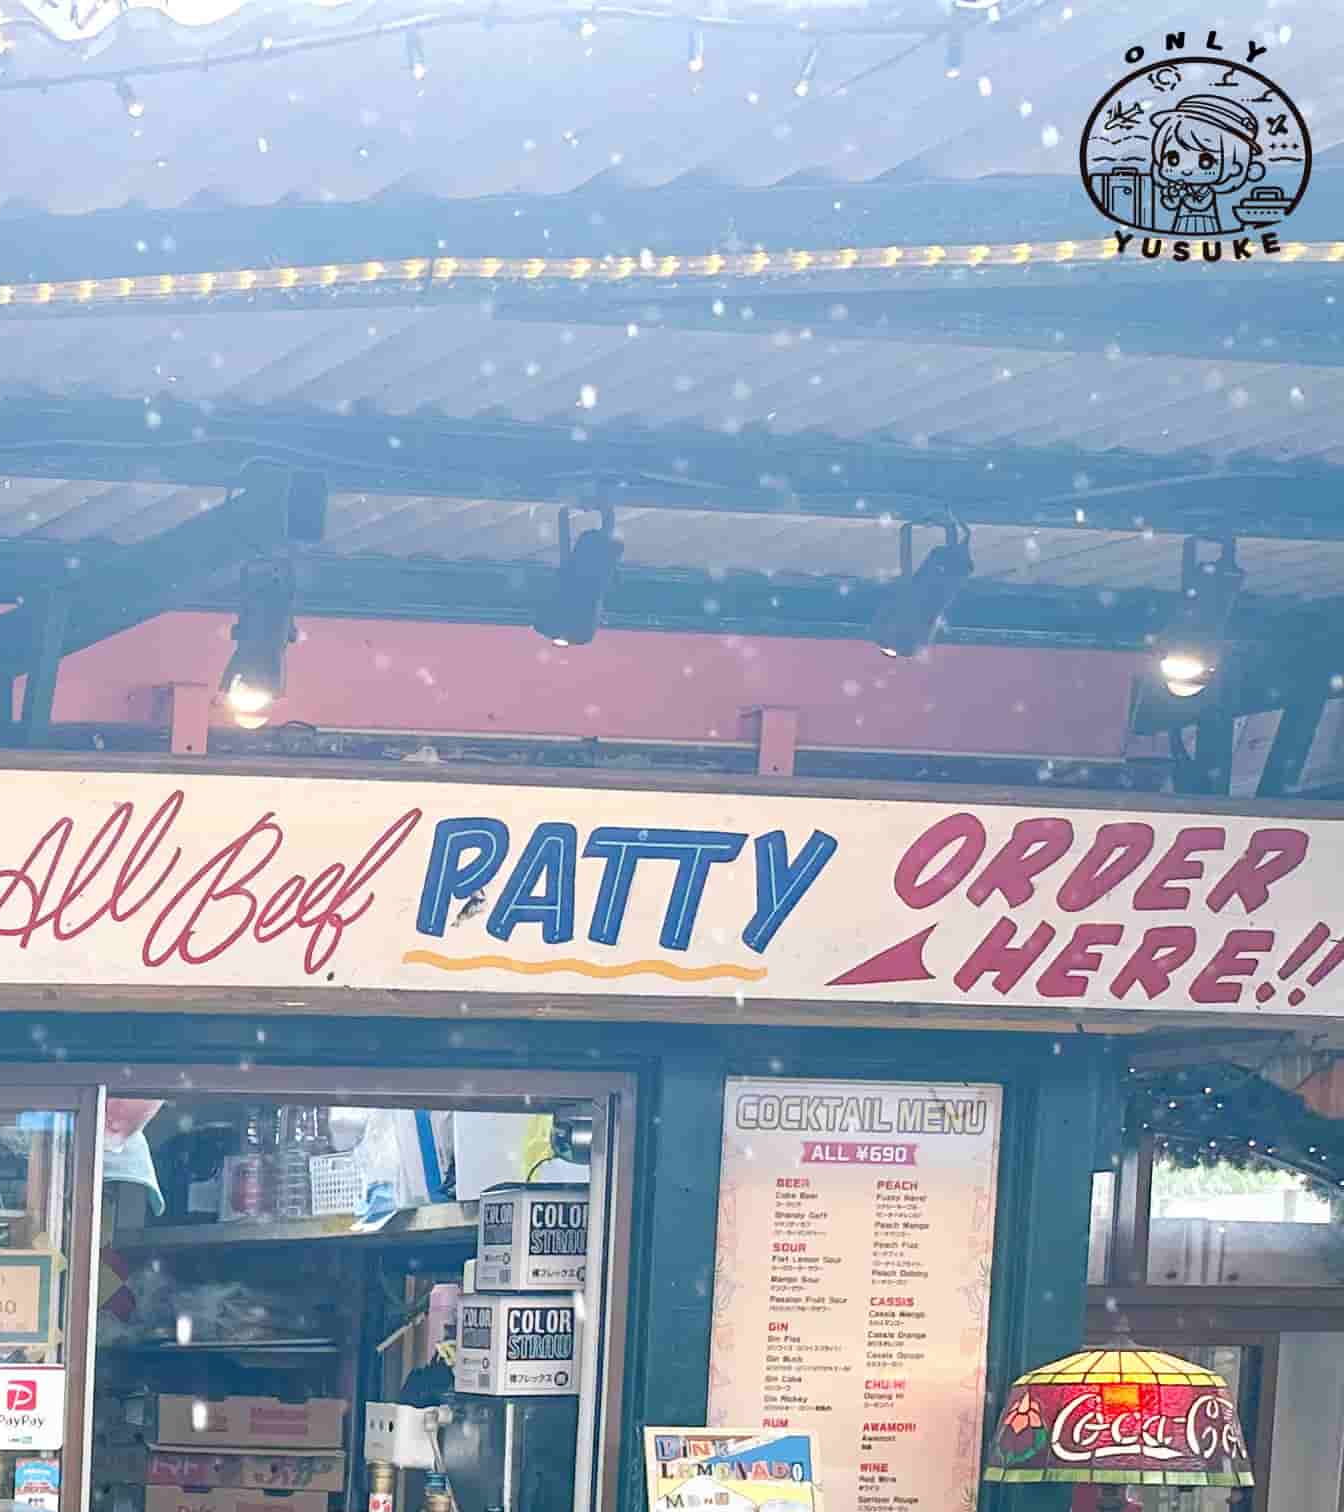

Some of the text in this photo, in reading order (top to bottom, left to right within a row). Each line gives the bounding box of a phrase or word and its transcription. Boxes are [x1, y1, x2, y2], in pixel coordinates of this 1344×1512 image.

[893, 812, 1310, 915] ORDER
[143, 807, 424, 975] Beef
[414, 815, 840, 955] PATTY
[953, 915, 1344, 1007] HERE!!
[735, 1093, 987, 1136] COCKTAIL MENU
[810, 1144, 908, 1163] ALL ¥690
[775, 1177, 919, 1191] BEER PEACH
[531, 1203, 588, 1229] COLO
[772, 1242, 807, 1253] SOUR
[870, 1296, 915, 1307] CASSIS
[509, 1309, 572, 1334] COLOR
[768, 1321, 789, 1332] GIN
[507, 1333, 573, 1360] STRAW
[862, 1422, 917, 1433] AWAMORI
[859, 1463, 889, 1473] WINE
